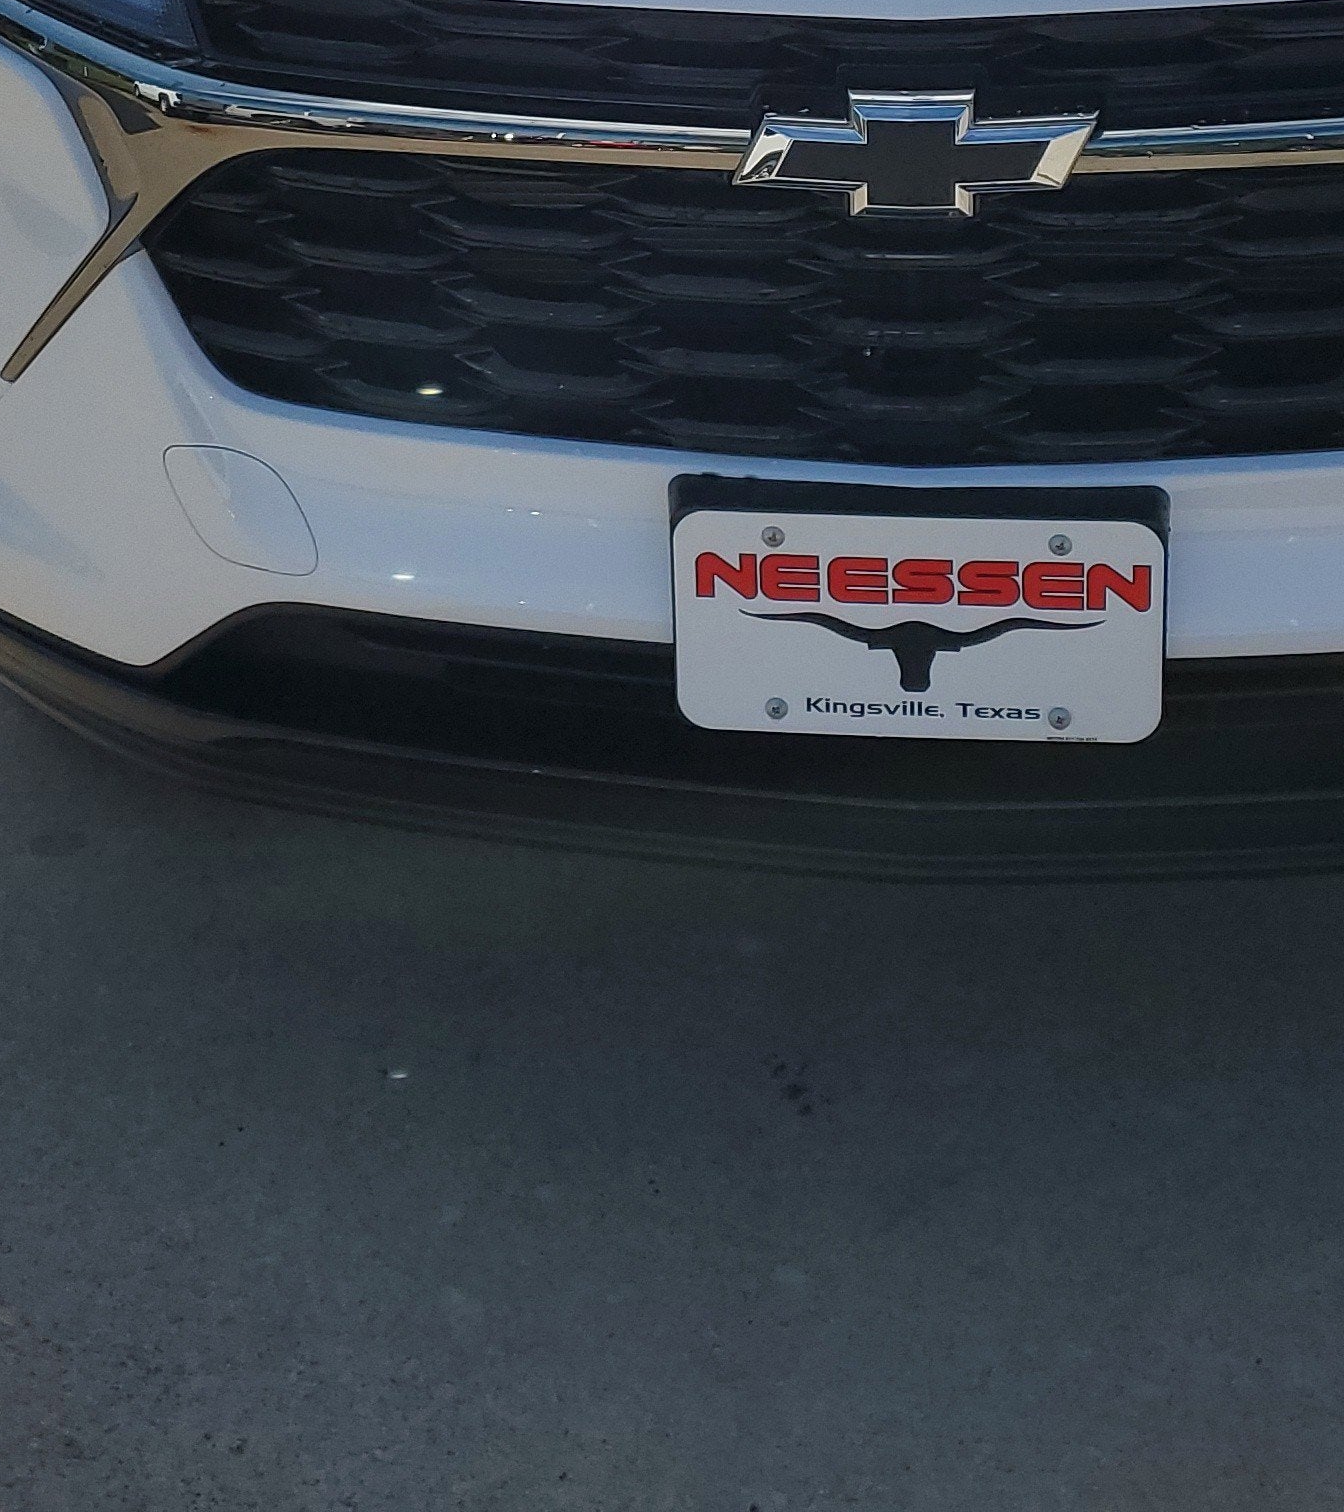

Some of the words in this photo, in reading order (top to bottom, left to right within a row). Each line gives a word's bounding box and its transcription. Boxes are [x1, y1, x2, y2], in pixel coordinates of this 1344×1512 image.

[695, 551, 1152, 613] NEESSEN
[805, 697, 946, 719] Kingsville,
[955, 701, 1041, 721] Texas
